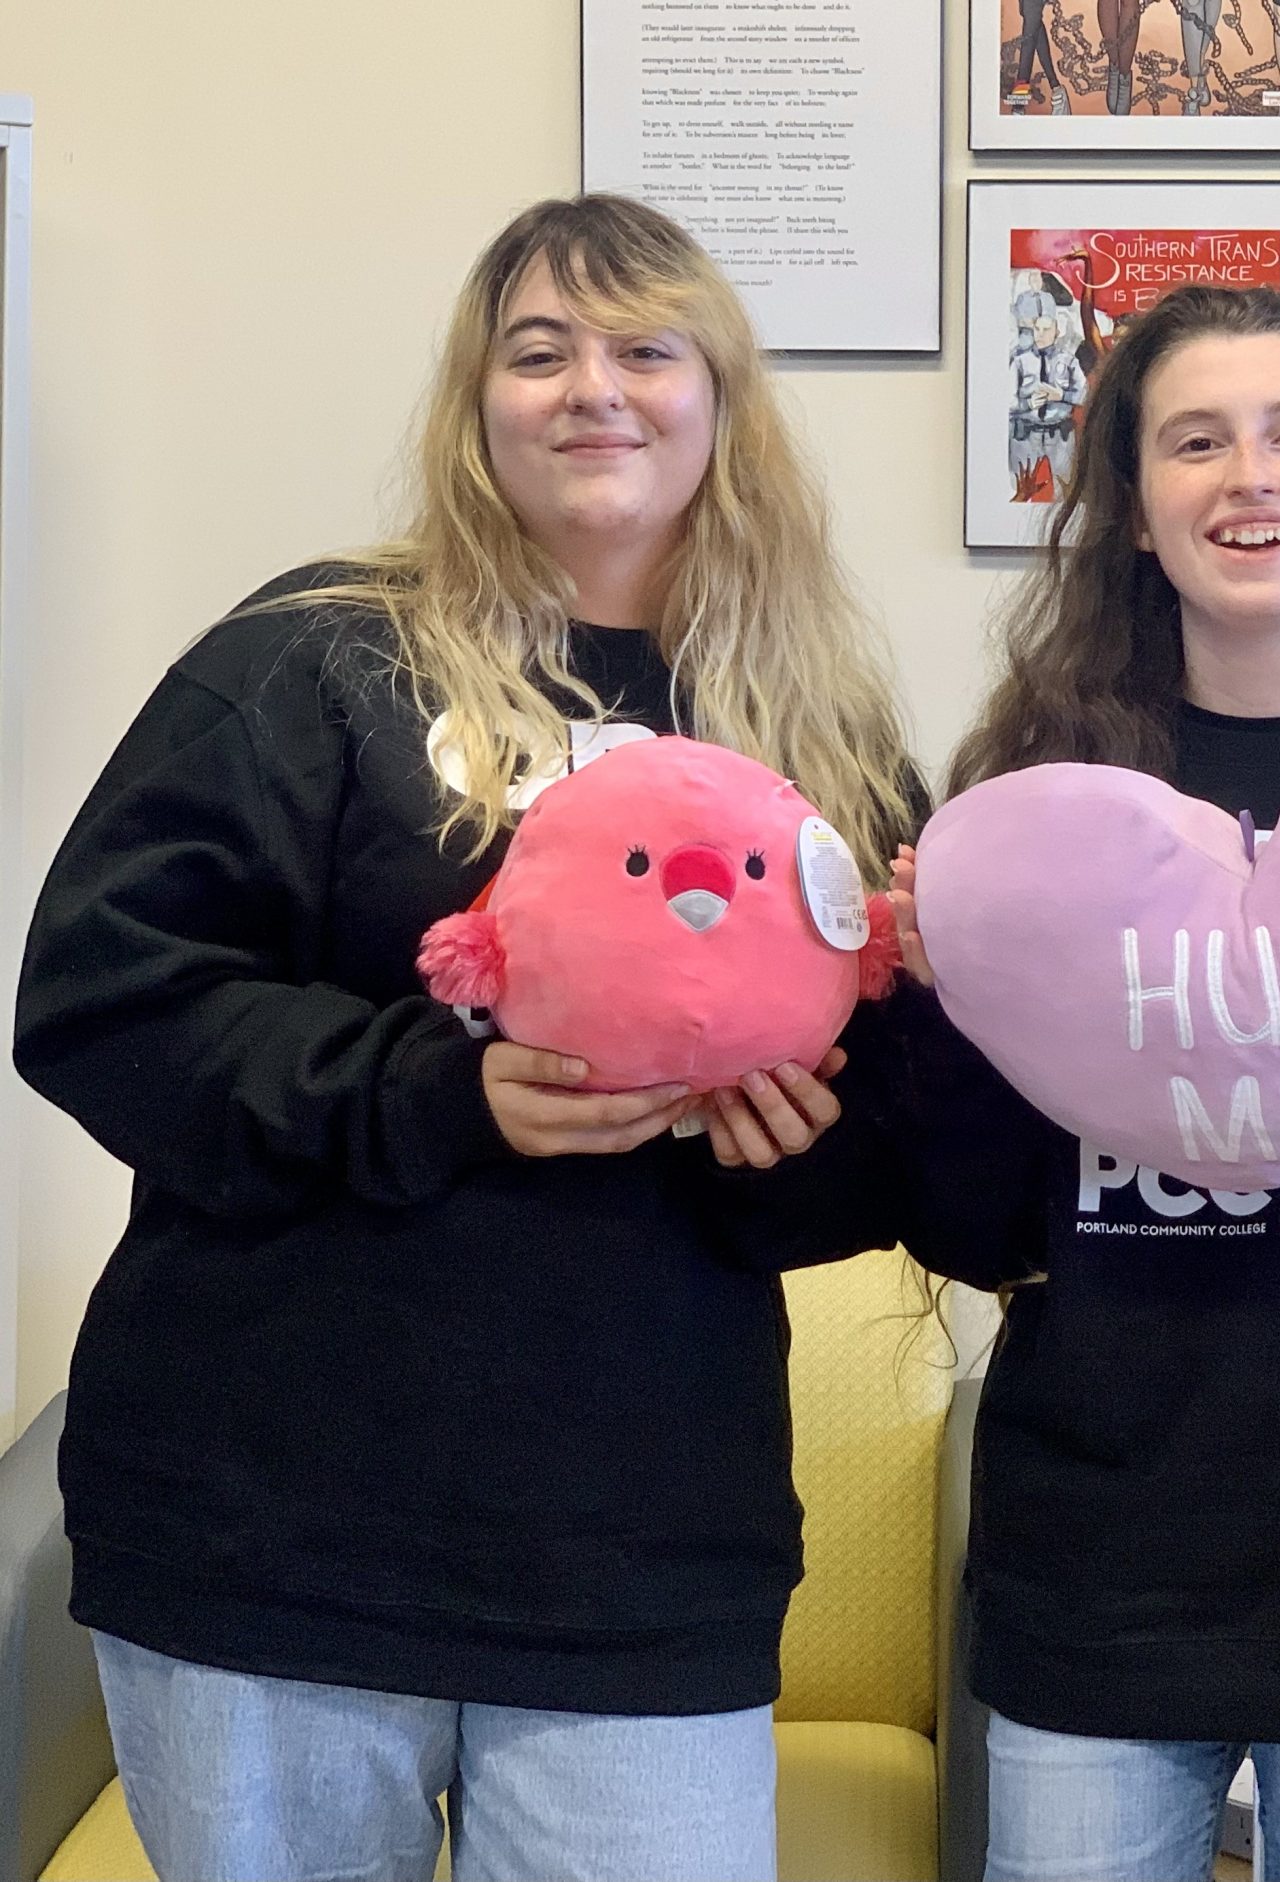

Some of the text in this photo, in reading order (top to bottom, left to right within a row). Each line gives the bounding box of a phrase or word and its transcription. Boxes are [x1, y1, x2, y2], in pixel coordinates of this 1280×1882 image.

[1198, 234, 1279, 267] TRANS
[1126, 264, 1254, 281] RESISTANCE
[1076, 1222, 1267, 1237] PORTLAND COMMUNITY COLLEGE
